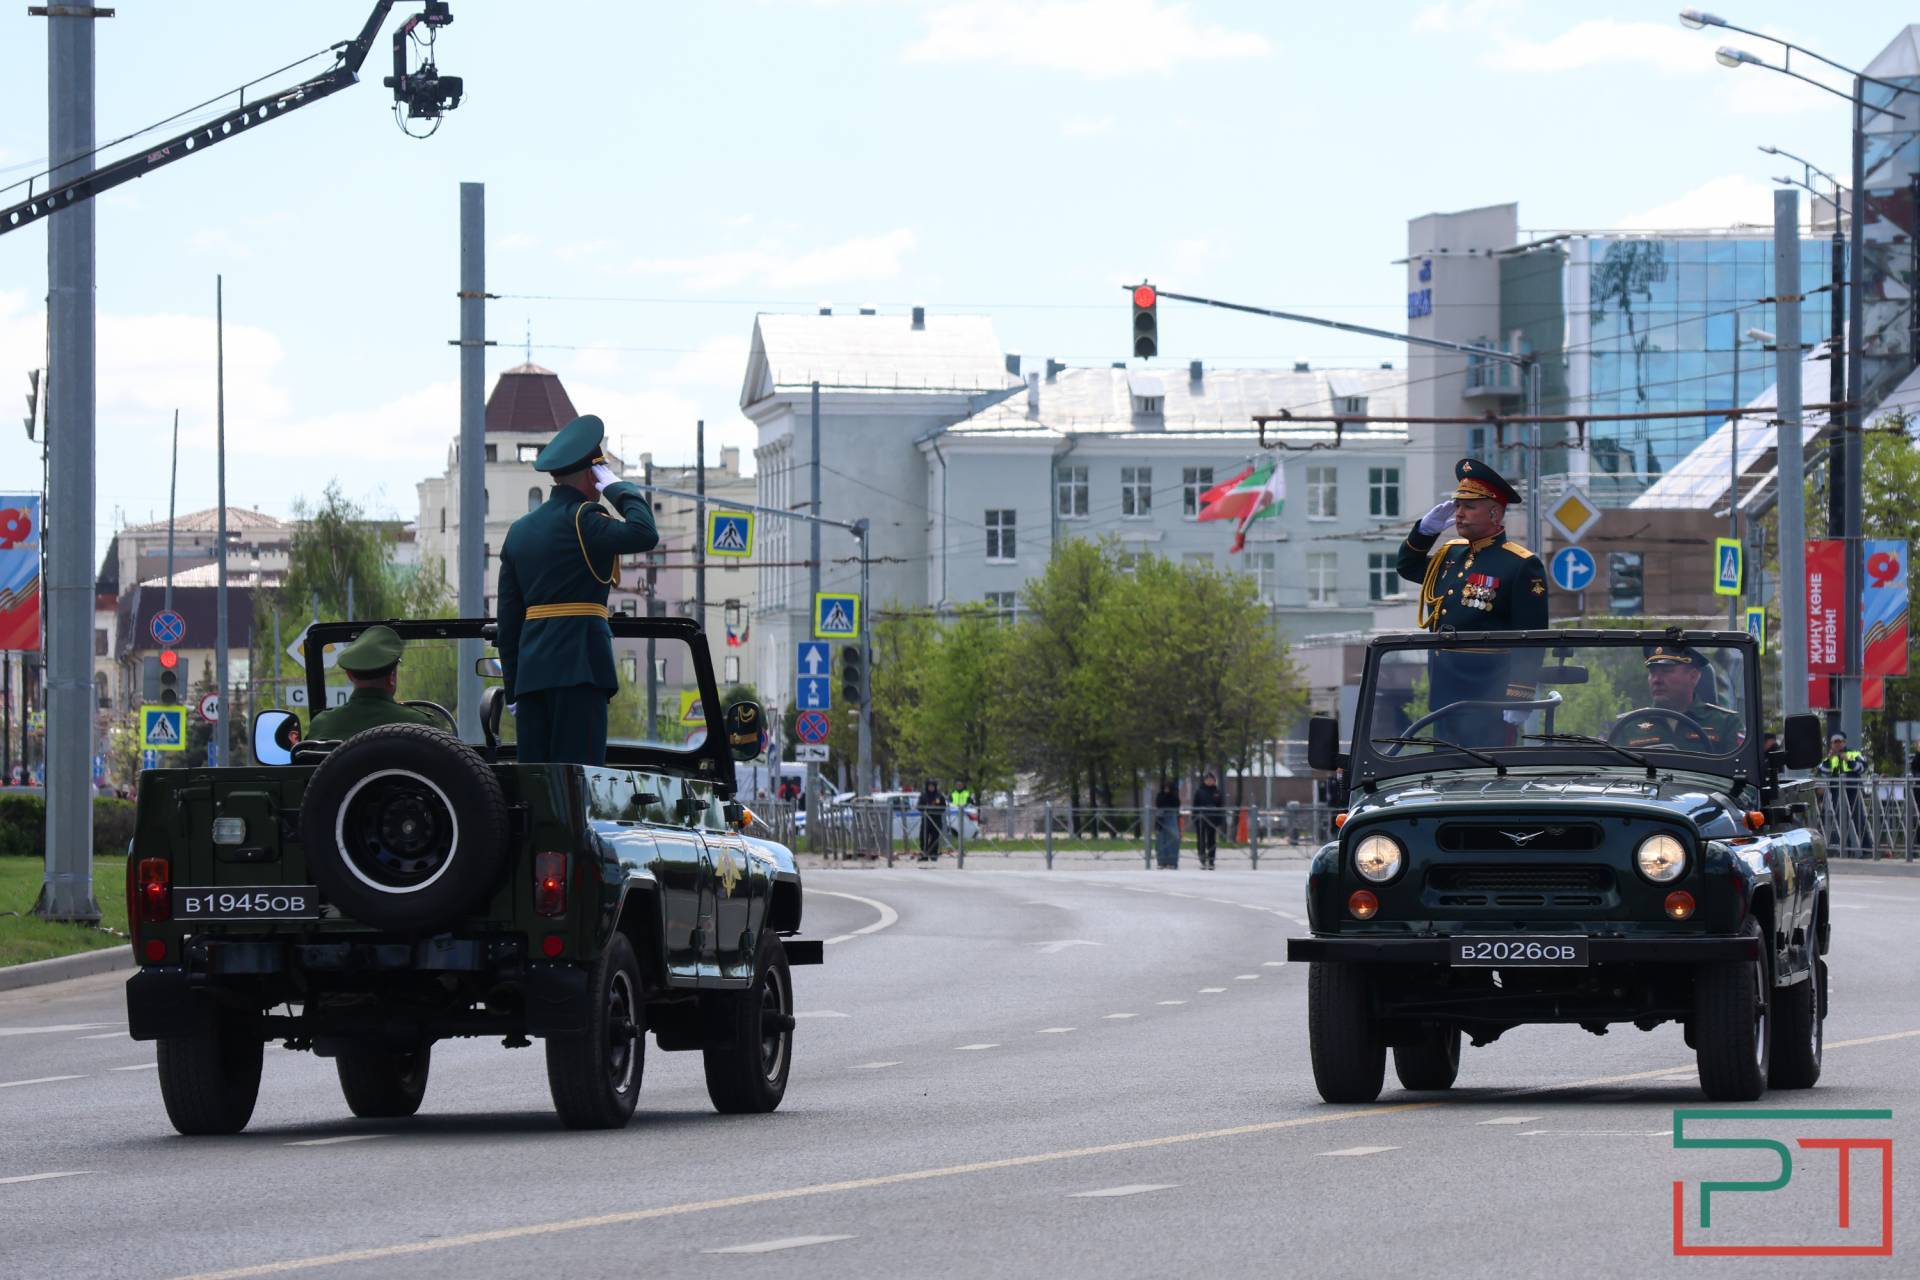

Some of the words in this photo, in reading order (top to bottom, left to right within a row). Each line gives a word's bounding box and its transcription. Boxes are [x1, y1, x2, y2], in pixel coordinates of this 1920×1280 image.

[1867, 552, 1900, 588] 9
[185, 893, 305, 913] В1945ОВ
[1461, 942, 1576, 960] В2026ОВ
